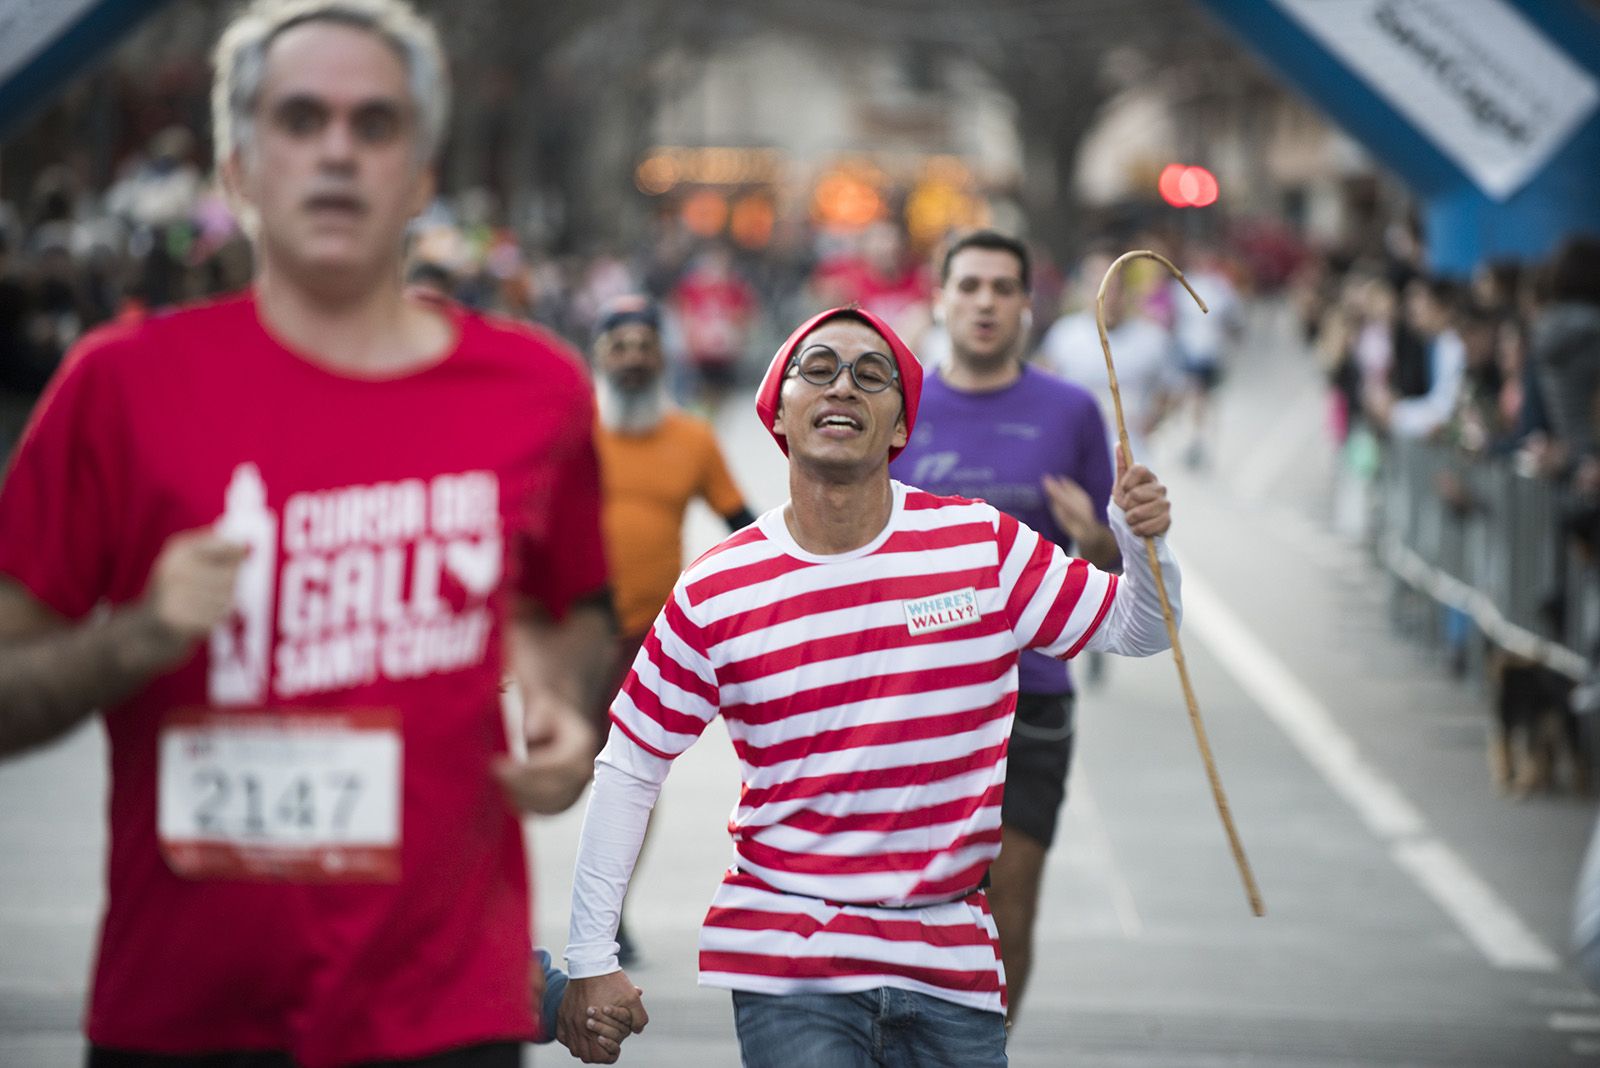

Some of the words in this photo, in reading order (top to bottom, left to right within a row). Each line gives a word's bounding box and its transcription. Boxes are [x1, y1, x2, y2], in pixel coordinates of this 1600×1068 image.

[907, 591, 974, 616] WHERE'S
[911, 604, 974, 629] WALLY?
[193, 771, 364, 832] 2147
